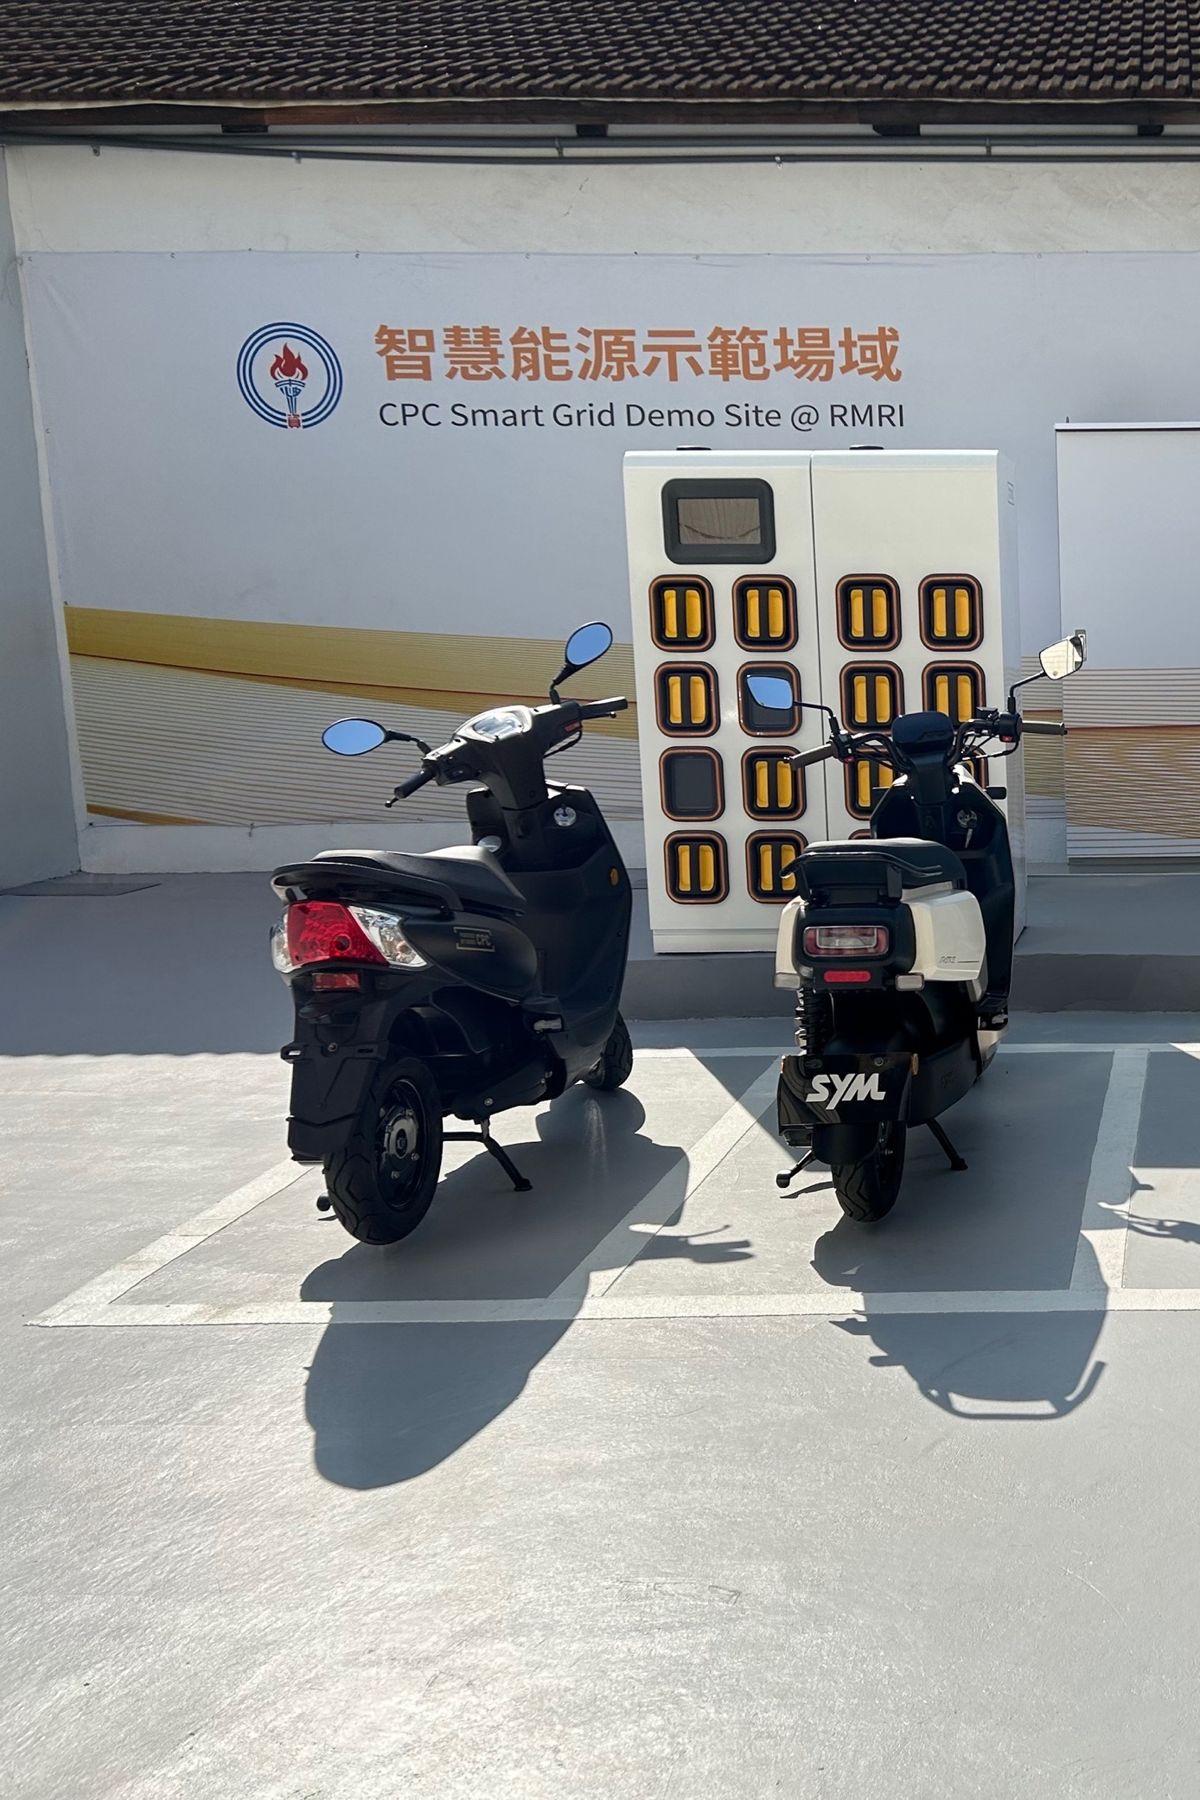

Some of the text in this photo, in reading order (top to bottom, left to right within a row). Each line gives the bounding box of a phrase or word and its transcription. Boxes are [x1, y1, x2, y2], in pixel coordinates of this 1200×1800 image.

[374, 324, 903, 383] 智慧能源示範場域
[378, 401, 905, 433] CPC Smart Grid Demo Site @ RMRI
[805, 1072, 887, 1111] SYM
